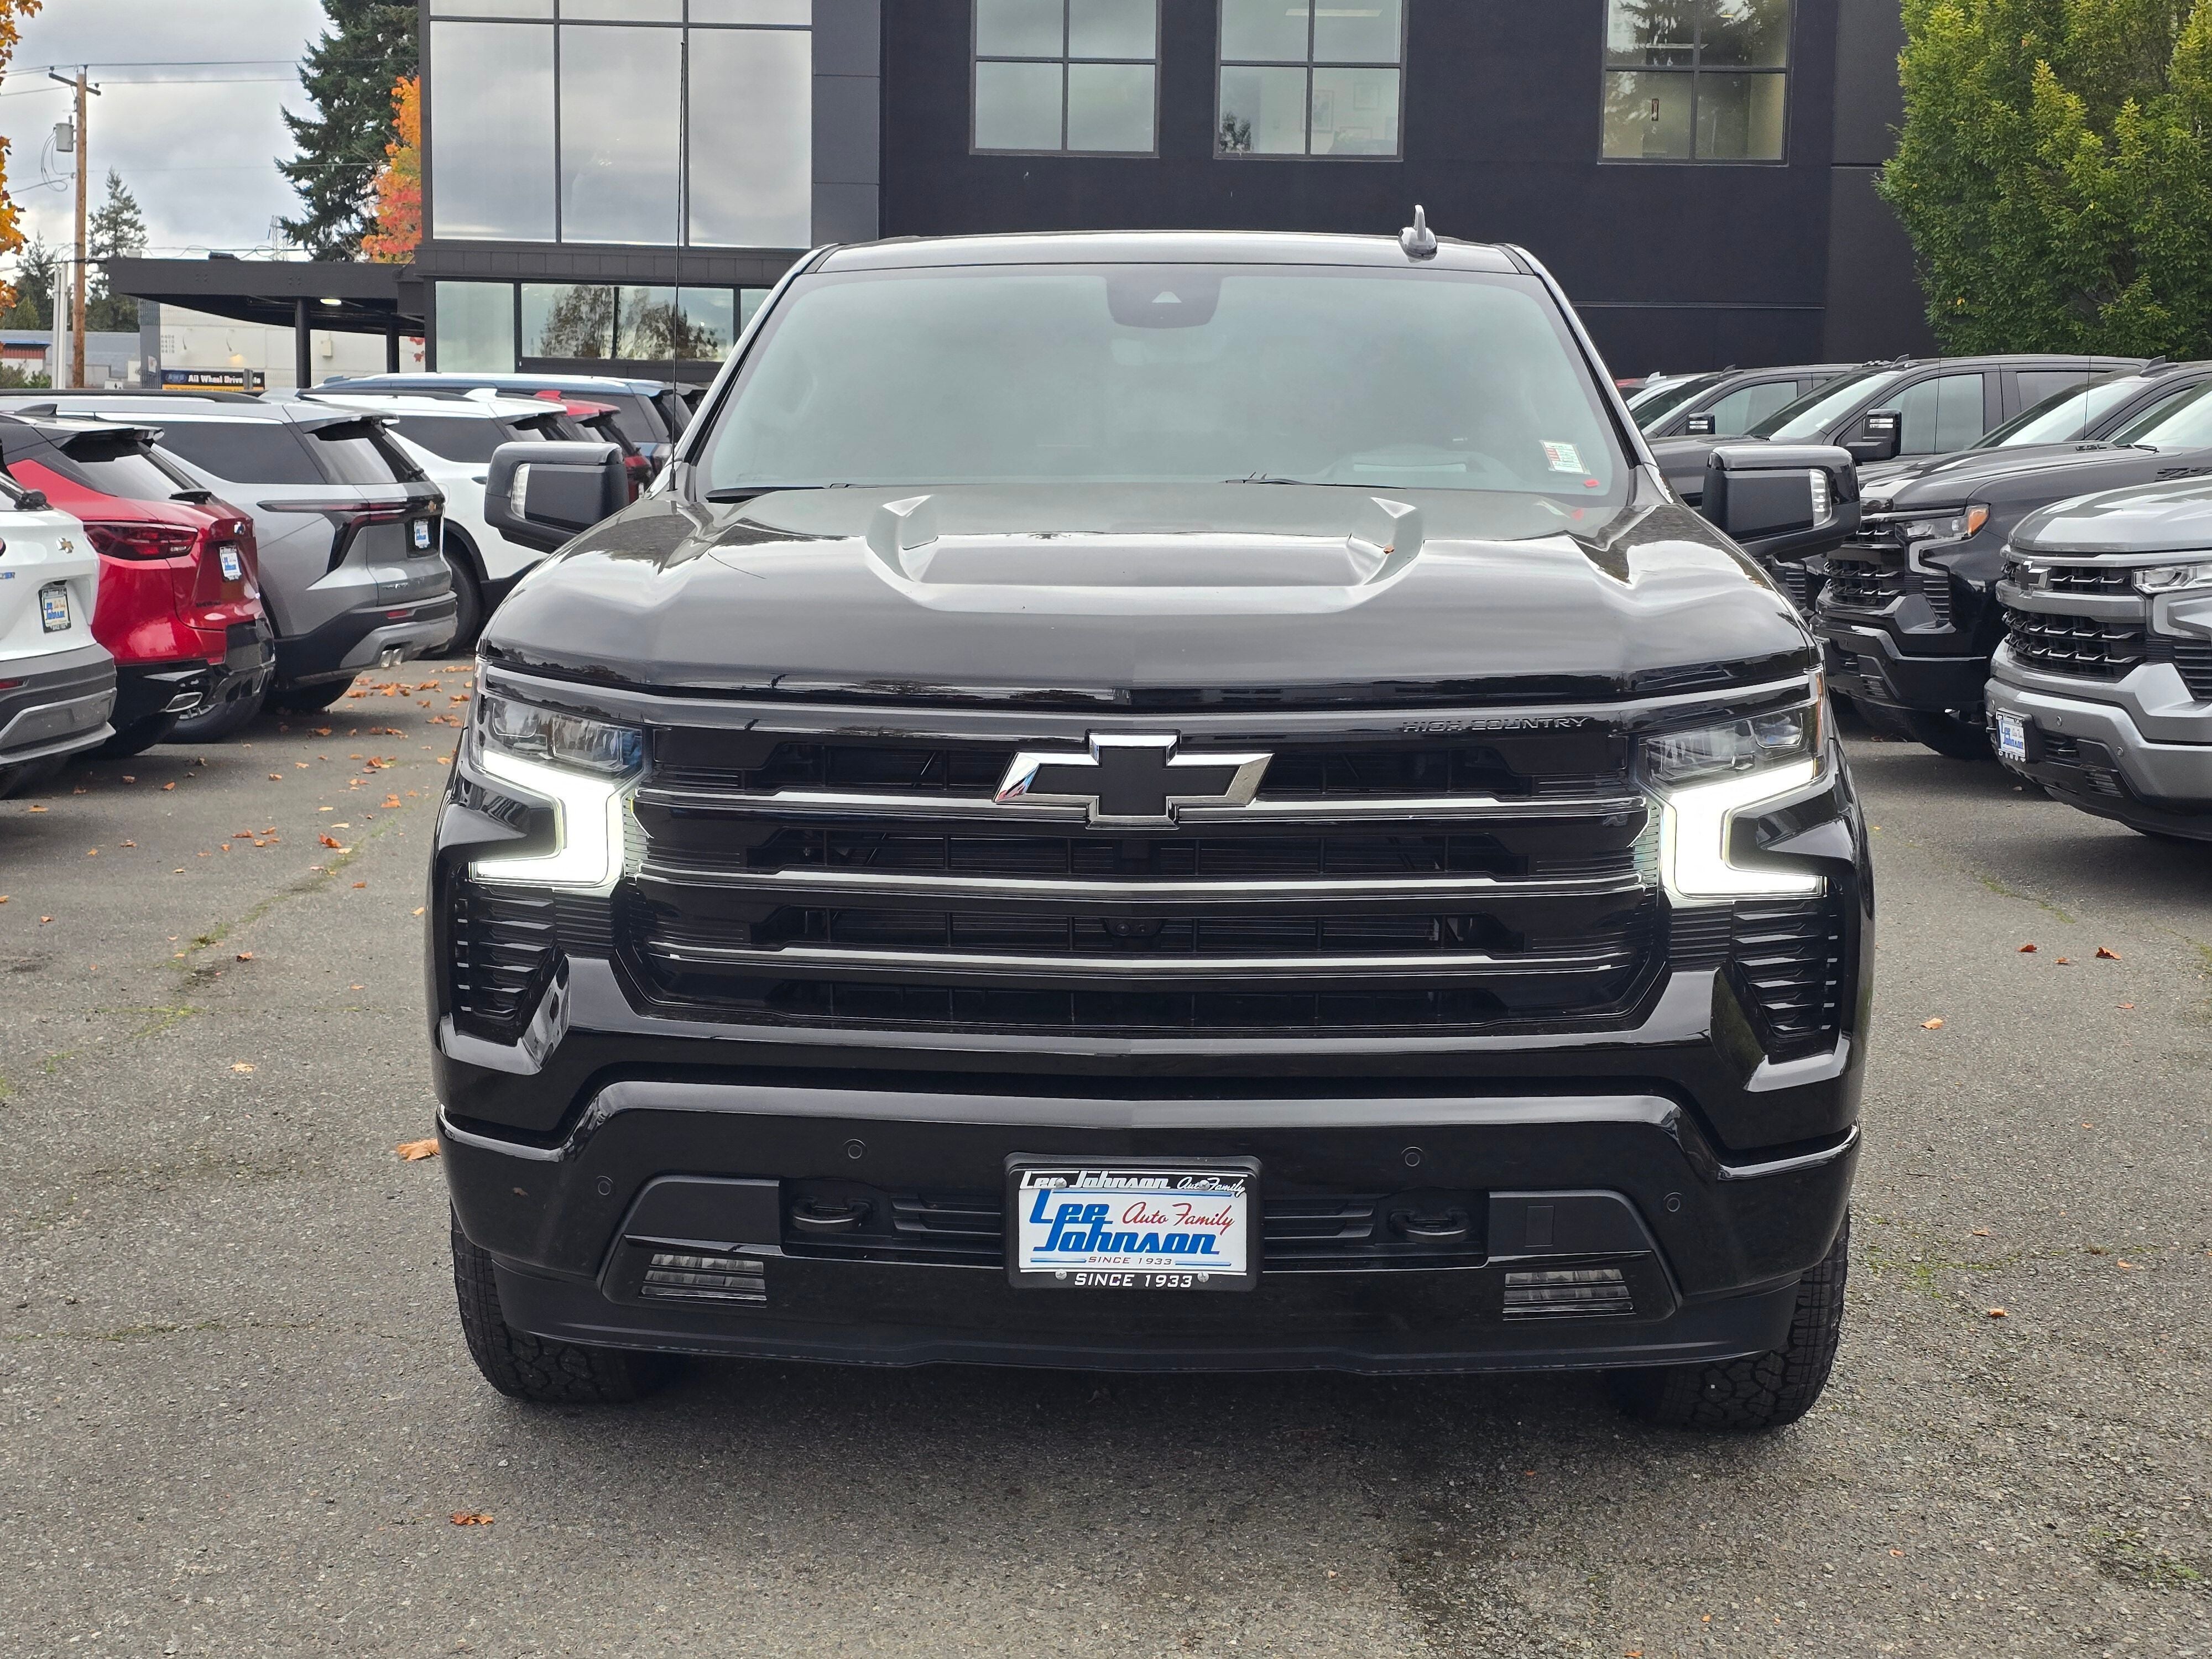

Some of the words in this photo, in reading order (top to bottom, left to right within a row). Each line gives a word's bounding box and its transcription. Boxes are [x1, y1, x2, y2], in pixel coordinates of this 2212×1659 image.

[1402, 721, 1462, 732] HIGH
[1471, 717, 1588, 731] COUNTRY
[1069, 1170, 1171, 1189] Johnson
[1177, 1176, 1208, 1190] Aut
[1207, 1177, 1245, 1197] Family
[1029, 1189, 1113, 1224] Lee
[1122, 1201, 1168, 1225] Auto
[1172, 1202, 1235, 1236] Family
[1032, 1211, 1220, 1255] Johnson
[1088, 1256, 1131, 1264] SINCE
[1074, 1272, 1135, 1287] SINCE
[1144, 1274, 1193, 1288] 1933
